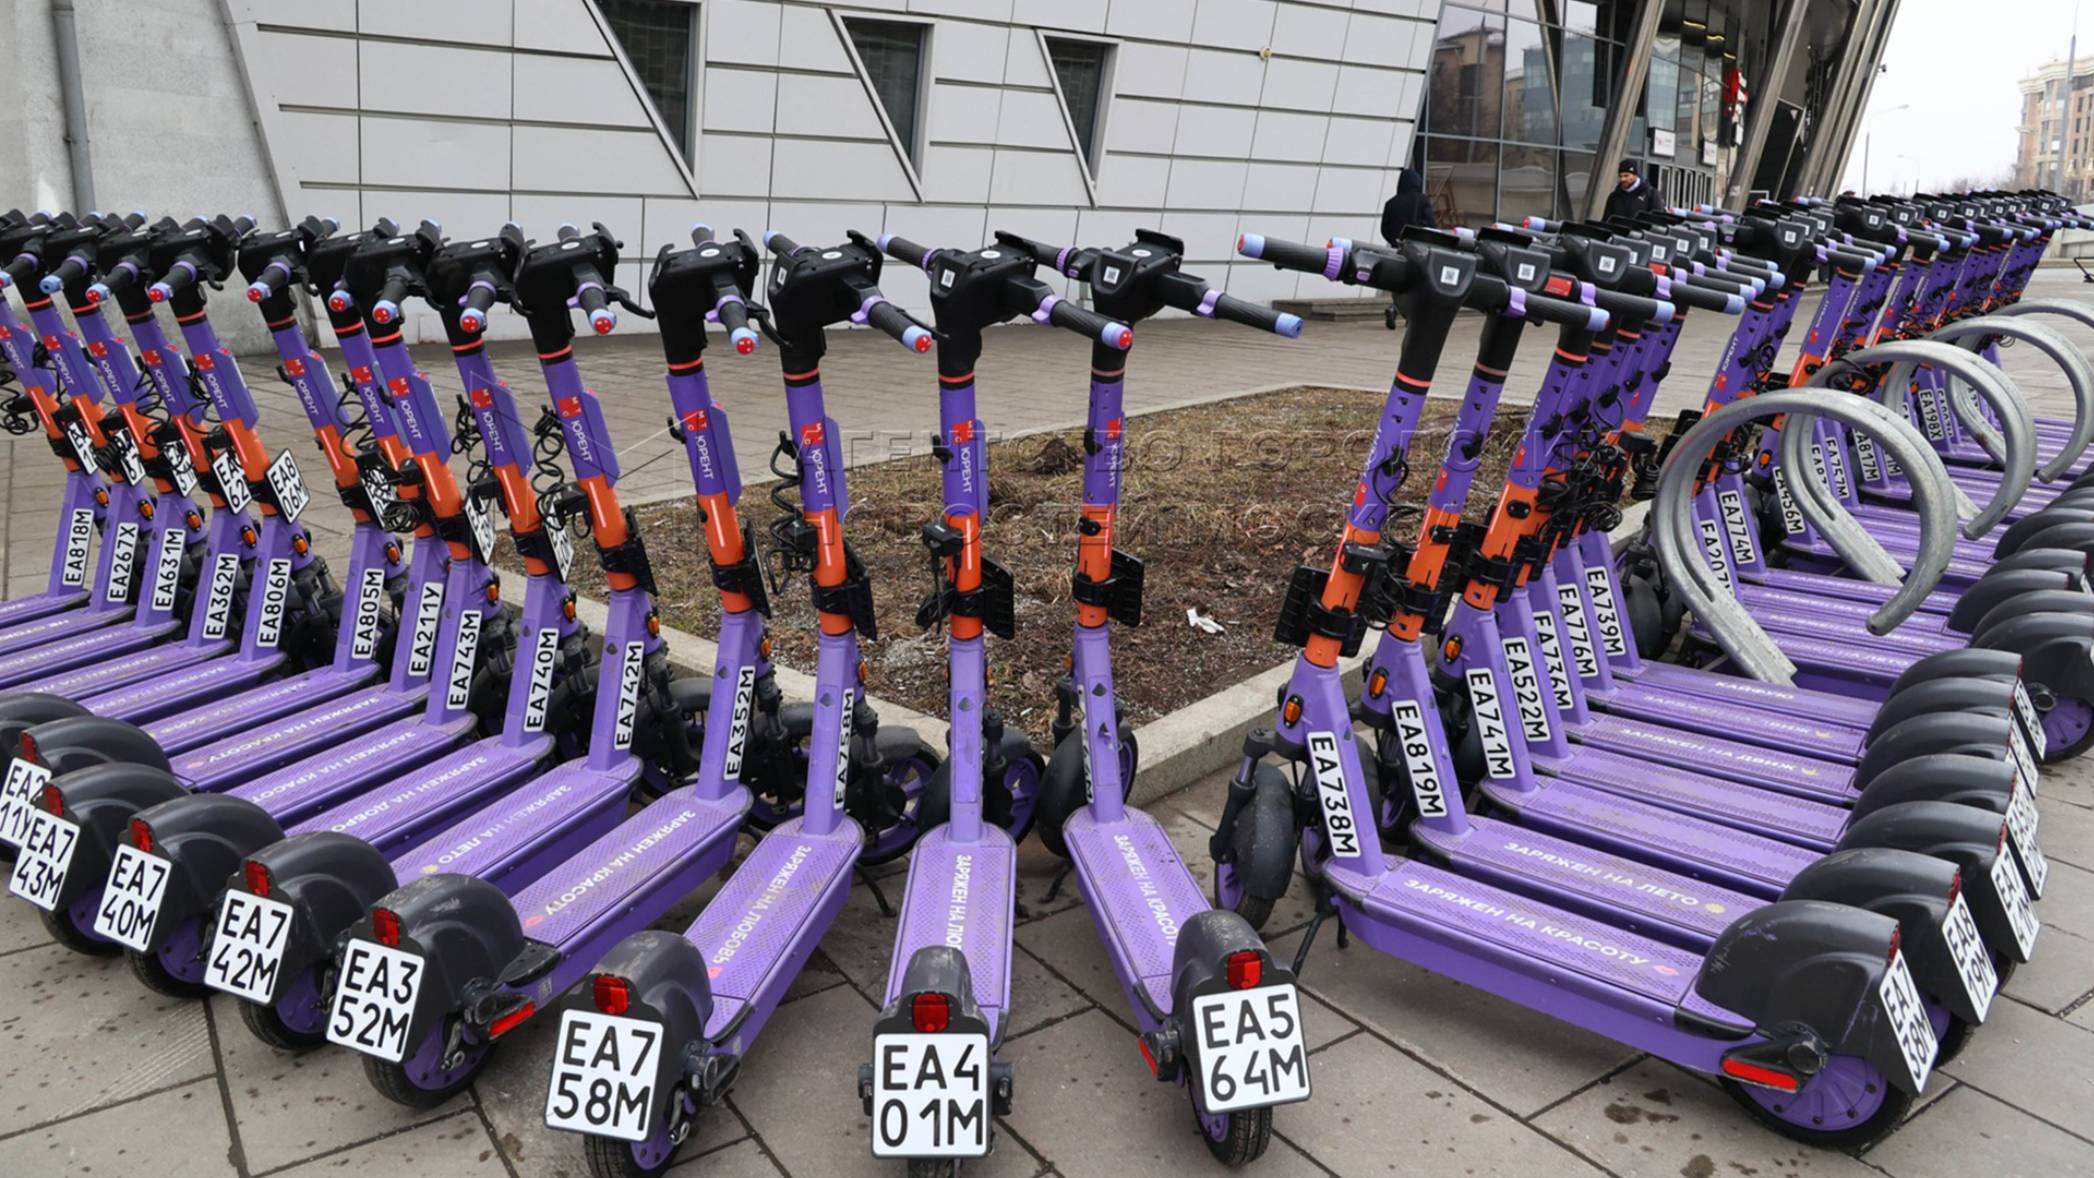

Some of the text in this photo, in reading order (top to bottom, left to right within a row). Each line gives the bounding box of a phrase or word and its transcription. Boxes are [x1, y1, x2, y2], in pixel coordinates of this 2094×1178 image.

[154, 367, 176, 403] ЮРЕНТ
[206, 373, 229, 410] ЮРЕНТ
[296, 378, 319, 416] ЮРЕНТ
[363, 386, 385, 424] ЮРЕНТ
[1920, 390, 1942, 438] ЕА198Х
[399, 399, 423, 440] ЮРЕНТ
[482, 411, 505, 453] ЮРЕНТ
[571, 420, 593, 463] ЮРЕНТ
[271, 456, 297, 494] ЕА8
[695, 435, 714, 480] ЮРЕНТ
[811, 448, 828, 495] ЮРЕНТ
[960, 447, 973, 494] ЮРЕНТ
[1856, 432, 1879, 480] А817М
[66, 510, 92, 583] ЕА818М
[1721, 493, 1753, 563] ЕА774М
[109, 525, 137, 600] ЕА267Х
[155, 530, 184, 609] ЕА631М
[206, 555, 237, 638] ЕА362М
[259, 560, 290, 645] ЕА806М
[354, 570, 384, 658] ЕА805М
[410, 585, 442, 673] ЕА211У
[1587, 570, 1623, 655] ЕА739М
[449, 612, 480, 707] ЕА743М
[1559, 587, 1597, 675] ЕА776М
[527, 630, 557, 729] ЕА740М
[615, 643, 643, 746] ЕА742М
[1505, 641, 1548, 739] ЕА522М
[208, 696, 380, 763] ЗАРЯЖЕН НА КРАСОТУ
[727, 668, 754, 776] ЕА352М
[835, 692, 854, 804] ЕА758М
[1469, 671, 1513, 776] ЕА741М
[1619, 728, 1799, 772] ЗАРЯЖЕН НА ДВИЖ
[250, 730, 417, 804] ЗАРЯЖЕН НА КРАСОТ
[1394, 705, 1444, 815] ЕА819М
[330, 756, 488, 833] ЗАРЯЖЕН НА ДОБРО
[437, 784, 572, 865] ЗАРЯЖЕН НА ЛЕТО
[1310, 737, 1358, 855] ЕА738М
[27, 815, 76, 864] ЕА7
[544, 809, 697, 916] ЗАРЯЖЕН НА КРАСОТУ
[1113, 834, 1151, 881] ЗАРЯЖЕН
[1138, 880, 1157, 898] НА
[16, 856, 66, 906] 43М
[111, 852, 166, 902] ЕА7
[713, 844, 812, 965] ЗАРЯЖЕН НА ЛЮБОВЬ
[951, 854, 973, 904] ЗАРЯЖЕН
[1503, 841, 1700, 907] ЗАРЯЖЕН НА ЛЕТО
[1995, 850, 2021, 916] ЕА7
[101, 898, 157, 945] 40М
[221, 898, 289, 951] ЕА7
[948, 904, 966, 921] НА
[1404, 879, 1651, 967] ЗАРЯЖЕН НА КРАСОТУ
[1947, 903, 1979, 969] ЕА8
[212, 947, 278, 998] 42М
[346, 949, 419, 1005] ЕА3
[1883, 961, 1918, 1033] ЕА7
[1967, 941, 1998, 1009] 19М
[333, 995, 411, 1055] 52М
[563, 1020, 656, 1077] ЕА7
[1202, 993, 1294, 1049] ЕА5
[1902, 1010, 1936, 1081] 38М
[883, 1044, 979, 1091] ЕА4
[1210, 1044, 1306, 1102] 64М
[553, 1072, 651, 1131] 58М
[880, 1098, 983, 1147] 01М
